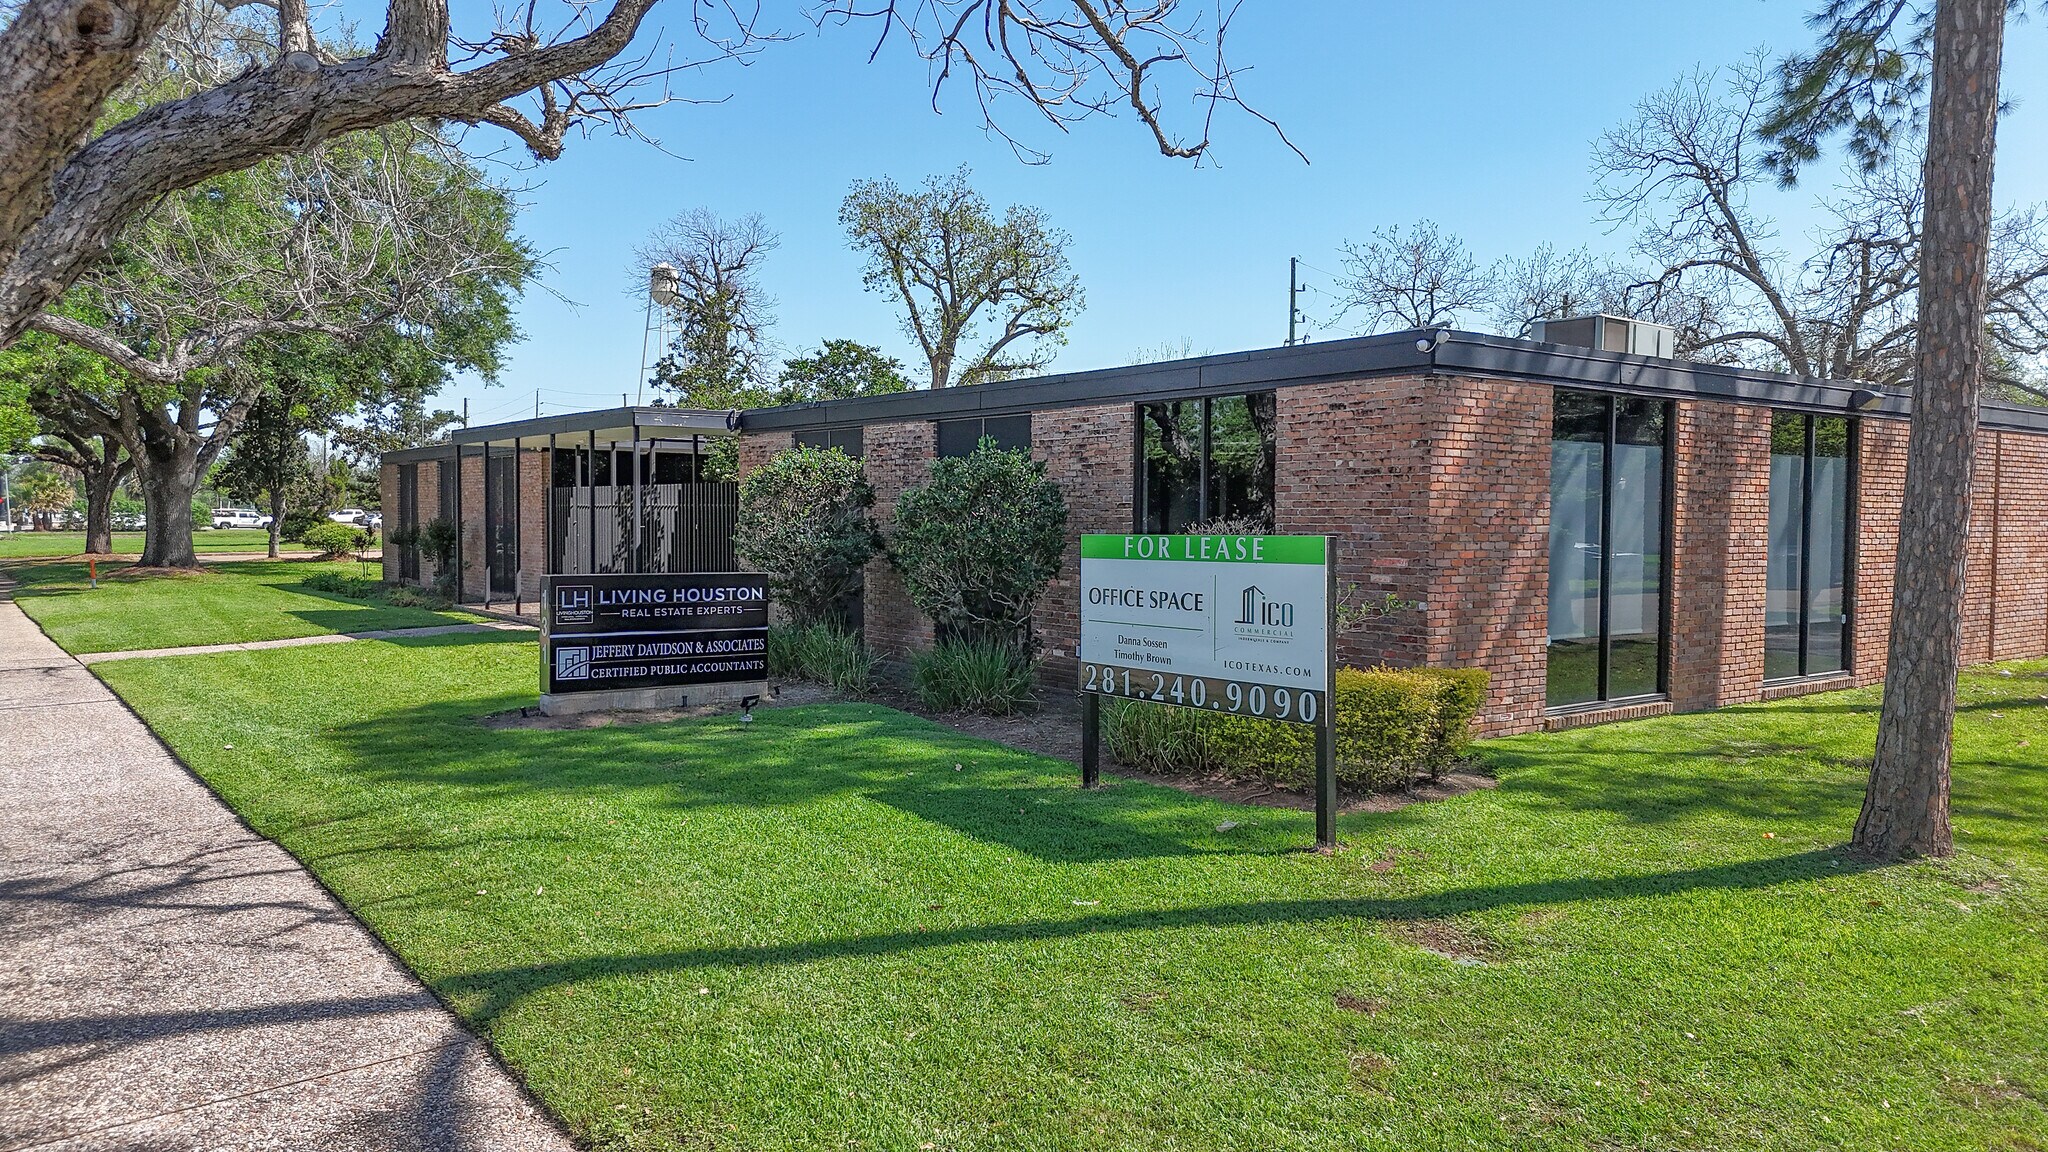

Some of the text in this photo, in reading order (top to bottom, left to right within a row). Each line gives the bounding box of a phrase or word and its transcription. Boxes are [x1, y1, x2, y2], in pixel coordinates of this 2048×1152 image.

[1124, 536, 1264, 561] FOR LEASE
[599, 586, 763, 605] LIVING HOUSTON
[1088, 587, 1204, 612] OFFICE SPACE
[621, 605, 743, 618] REAL ESTATE EXPERTS
[1234, 626, 1293, 637] COMMERCIAL
[592, 638, 765, 661] JEFFERY DAVIDSON & ASSOCIATES
[1117, 634, 1168, 650] Danna Sossen
[1113, 649, 1172, 666] Timothy Brown
[591, 660, 765, 679] CERTIFIED PUBLIC ACCOUNTANTS
[1223, 660, 1312, 678] ICOTEXAS.COM
[1085, 663, 1318, 723] 281.240.9090
